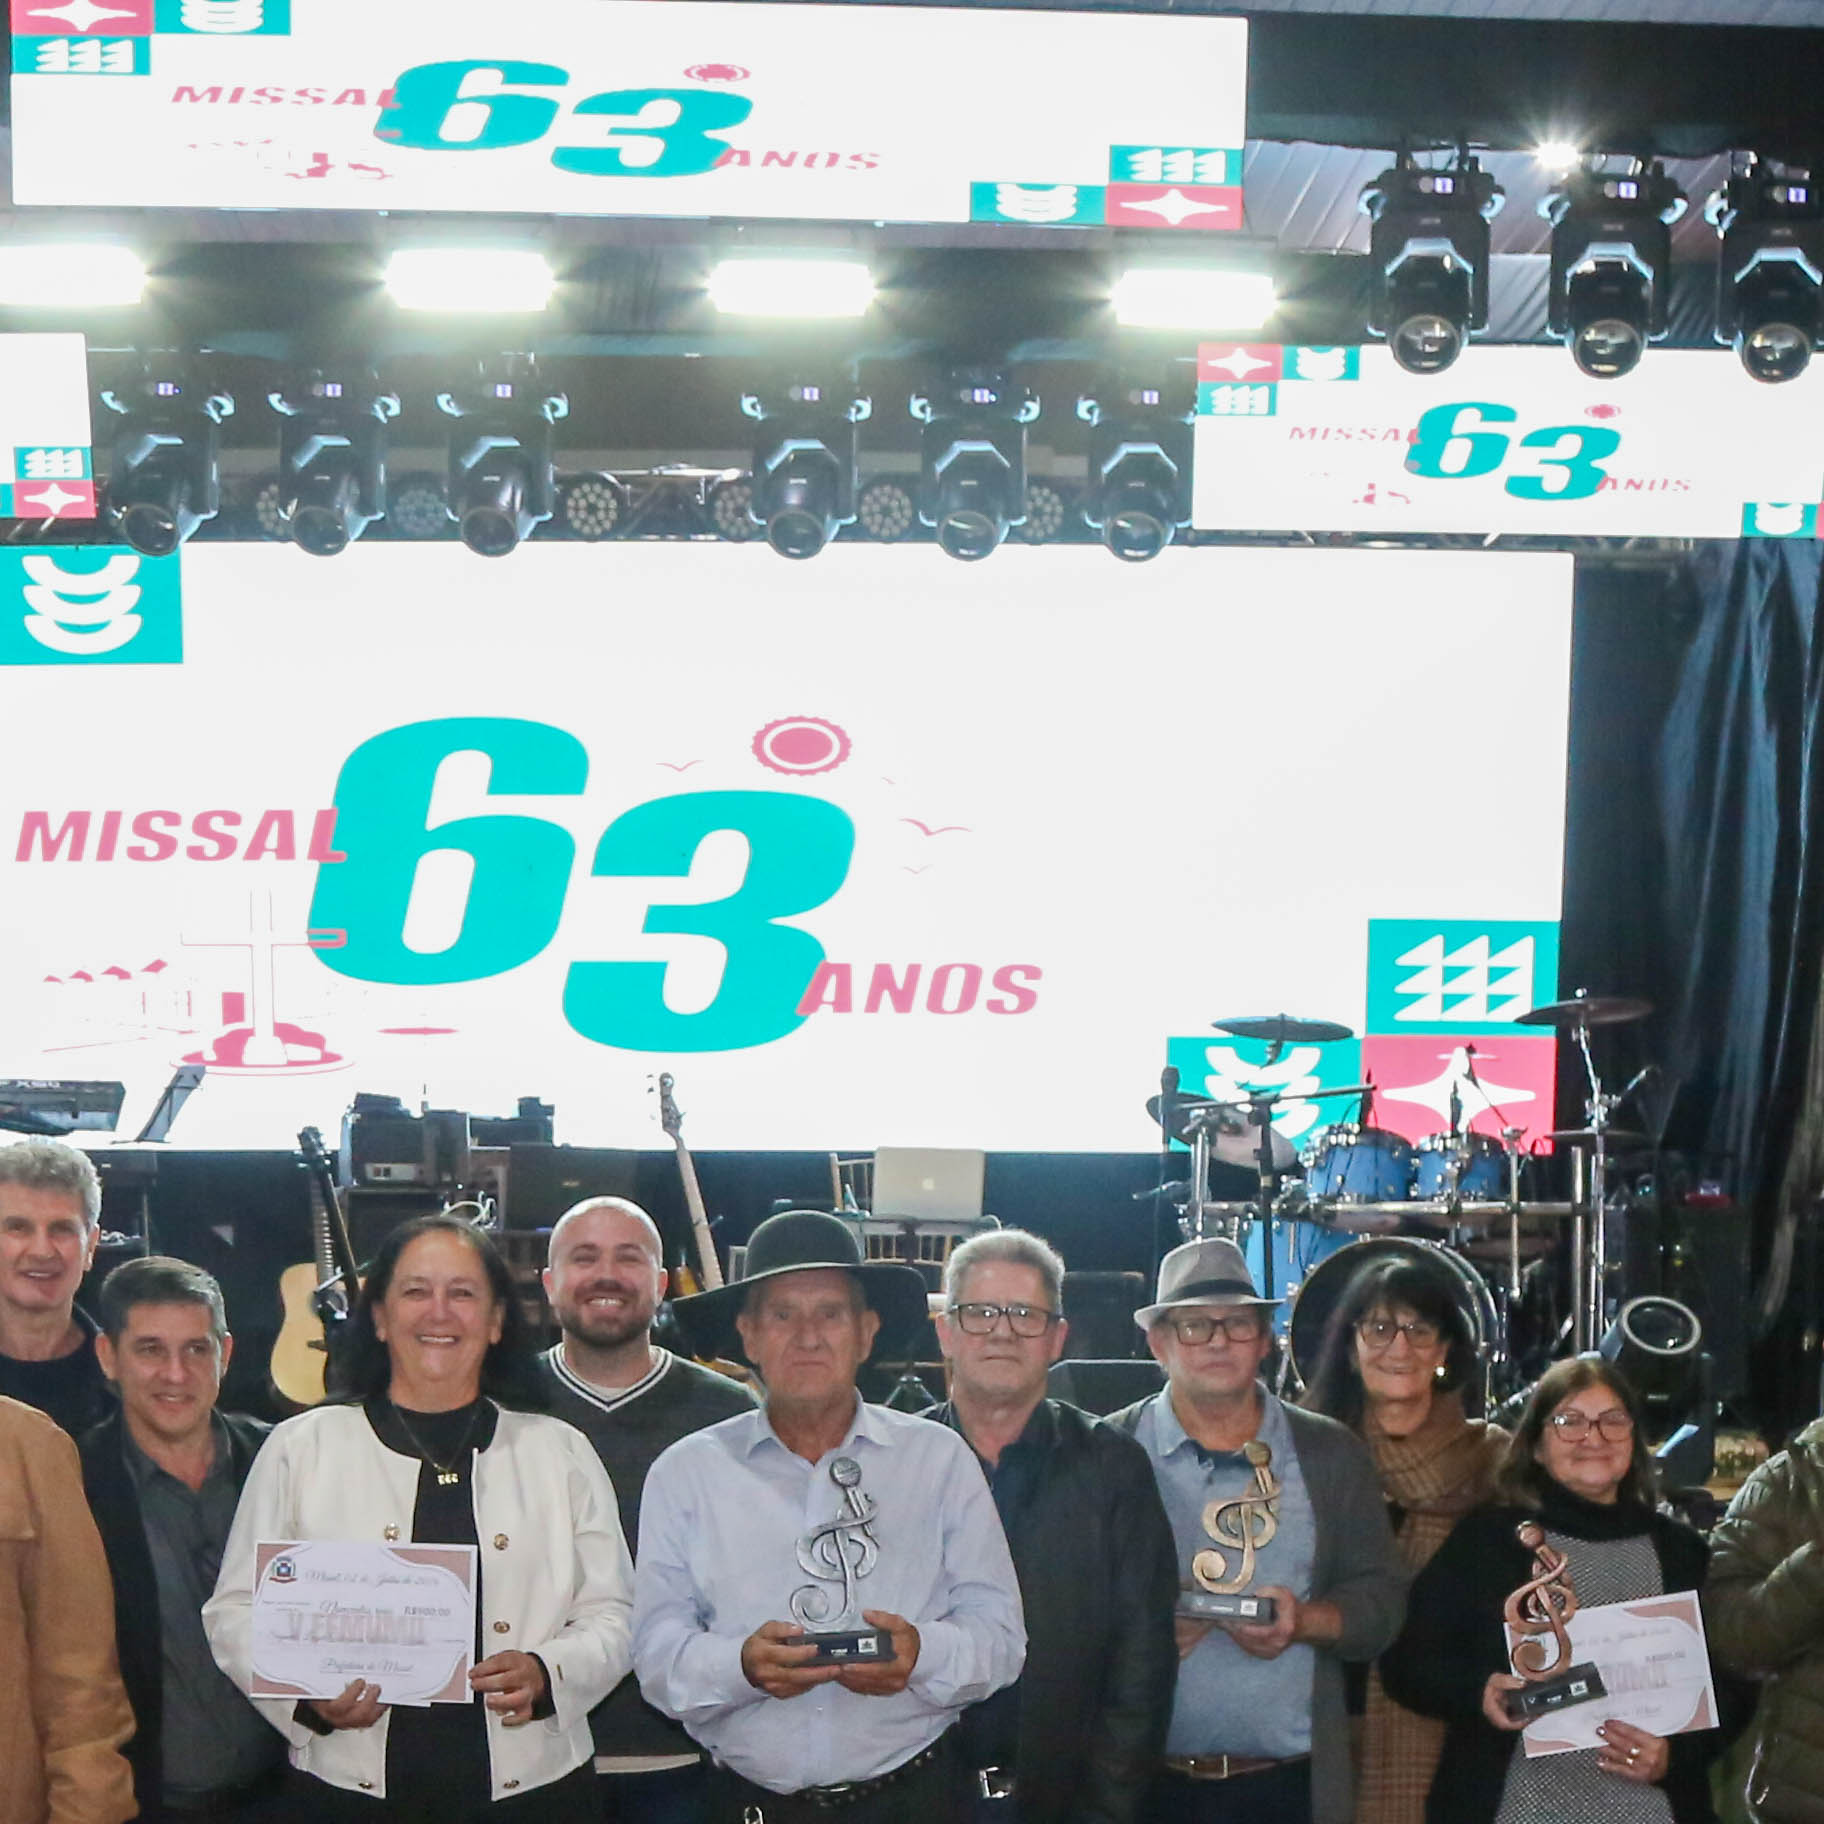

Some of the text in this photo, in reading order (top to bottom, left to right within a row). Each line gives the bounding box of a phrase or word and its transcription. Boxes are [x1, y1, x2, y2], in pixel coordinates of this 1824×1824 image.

[172, 59, 880, 178] MISSAL 63 ANOS
[1404, 401, 1622, 501] 63
[14, 716, 1044, 1054] MISSAL 63 ANOS
